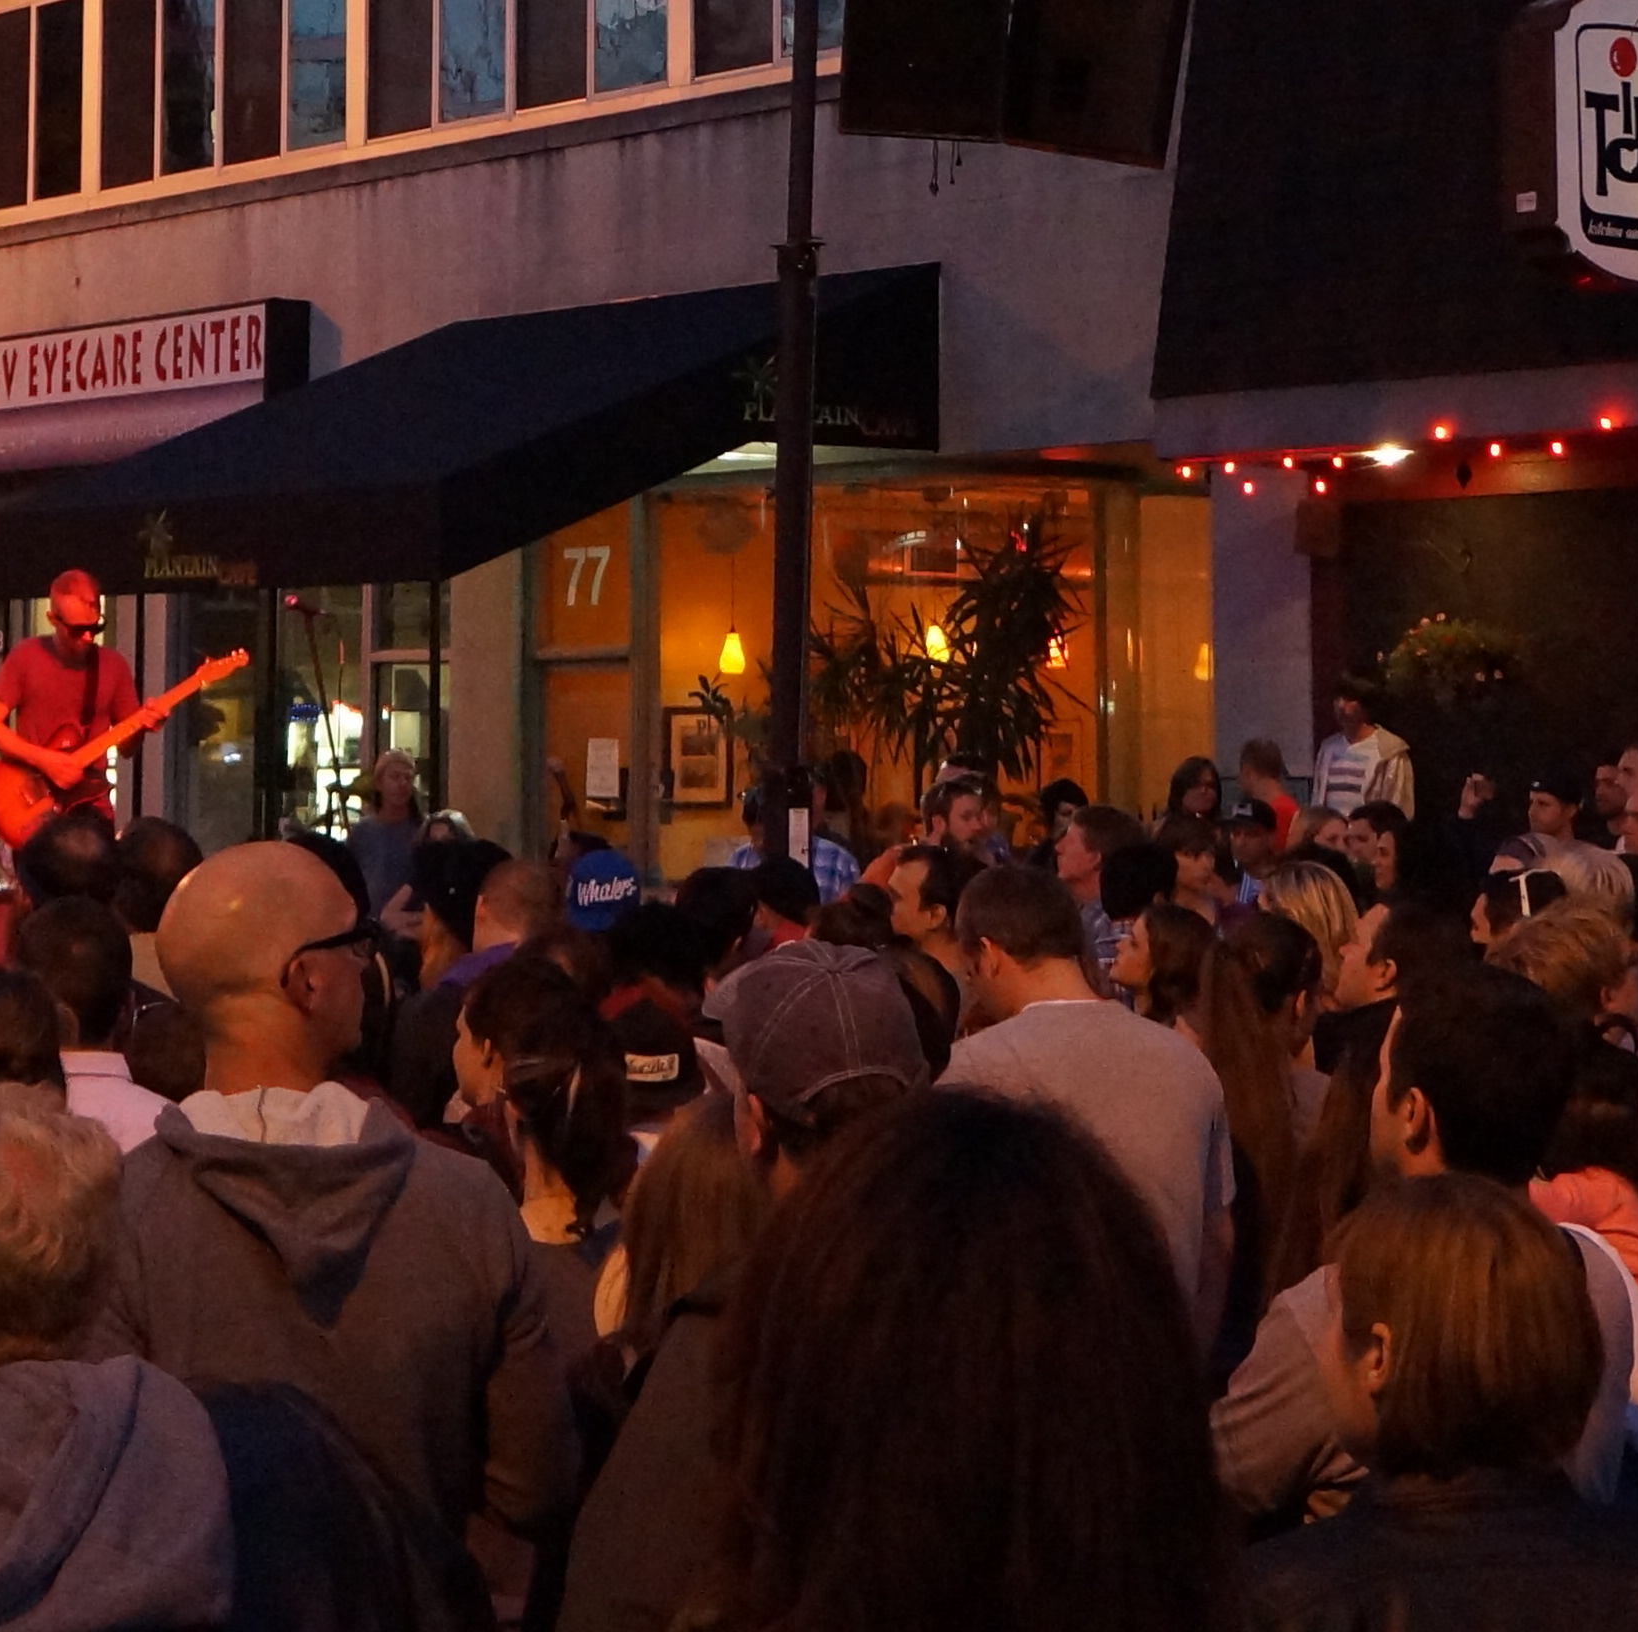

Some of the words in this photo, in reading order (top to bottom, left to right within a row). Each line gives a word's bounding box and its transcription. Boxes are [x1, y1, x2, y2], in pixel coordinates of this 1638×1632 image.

[27, 329, 143, 397] EYECARE
[154, 314, 263, 382] CENTER
[743, 398, 861, 426] PLAIN
[564, 546, 611, 606] 77
